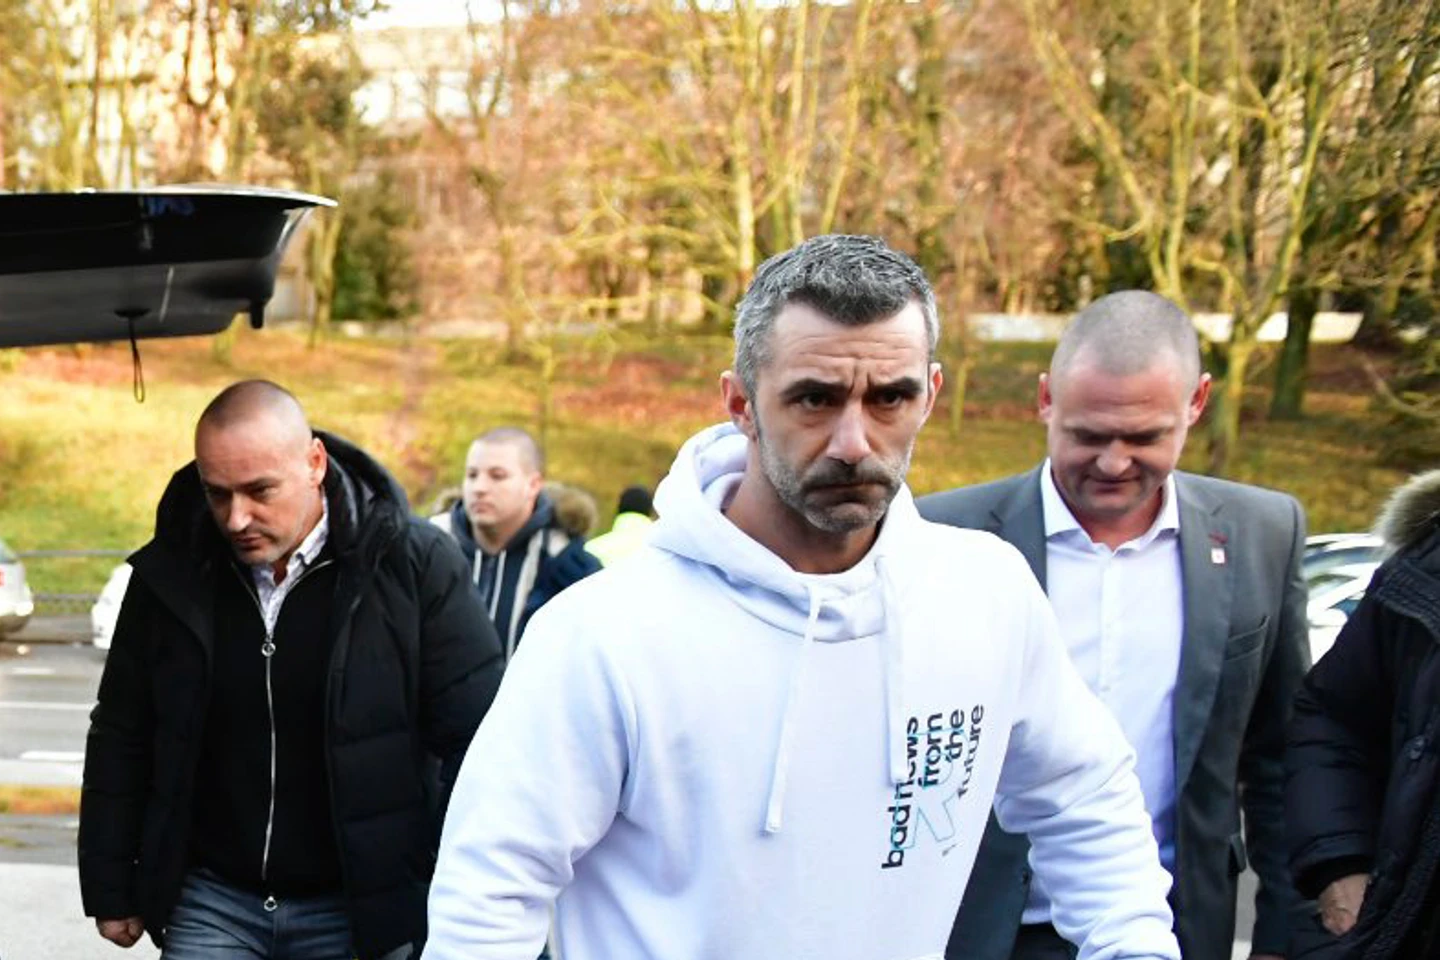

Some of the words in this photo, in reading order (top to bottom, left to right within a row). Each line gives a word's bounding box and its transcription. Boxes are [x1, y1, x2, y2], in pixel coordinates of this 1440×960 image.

[918, 713, 943, 788] from
[945, 709, 965, 763] the
[881, 804, 911, 869] bad
